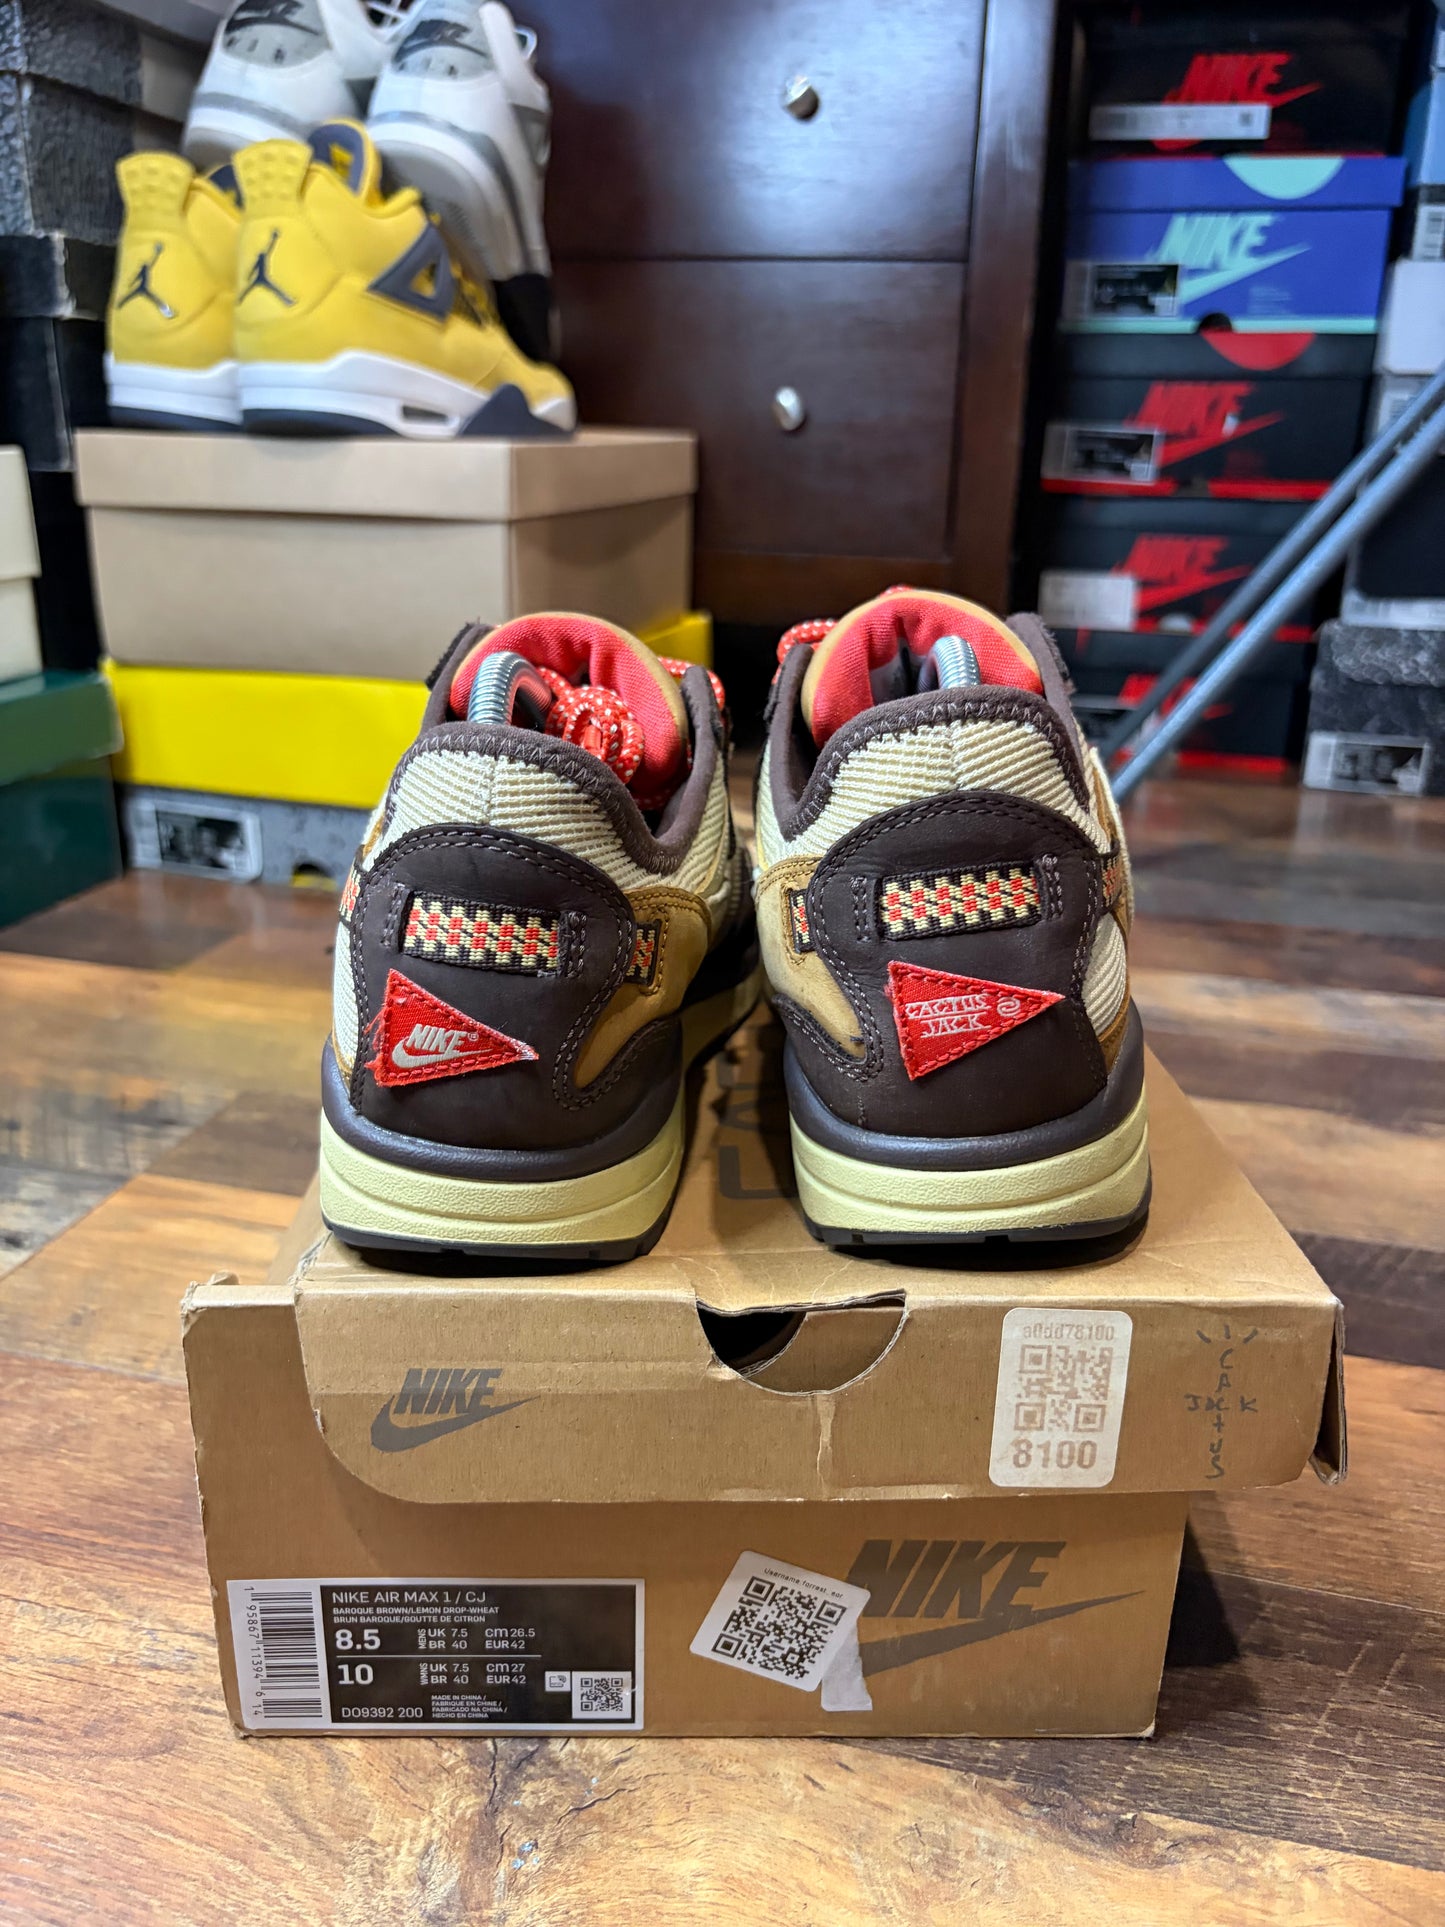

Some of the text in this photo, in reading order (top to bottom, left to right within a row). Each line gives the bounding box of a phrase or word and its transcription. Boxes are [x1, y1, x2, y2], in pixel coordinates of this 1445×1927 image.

[1174, 53, 1292, 103] NIKE
[1152, 213, 1277, 270] NIKE
[905, 993, 991, 1019] CACTUS
[920, 1012, 991, 1038] JACK
[406, 1023, 468, 1057] NIKE
[393, 1367, 504, 1415] NIKE
[1012, 1438, 1098, 1470] 8100
[845, 1539, 1067, 1619] NIKE
[332, 1591, 370, 1604] NIKE
[374, 1591, 400, 1603] AIR
[404, 1591, 439, 1603] MAX
[443, 1591, 452, 1603] 1
[465, 1591, 486, 1603] CJ
[333, 1606, 499, 1615] BAROQUE BROWN/LEMON DROP-WHEAT
[333, 1615, 486, 1624] BRUN BAROQUE/GOUTTE DE CITRON
[246, 1605, 260, 1640] 95867
[428, 1628, 446, 1637] UK
[451, 1628, 468, 1637] 7.5
[335, 1629, 381, 1650] 8.5
[418, 1628, 427, 1650] MENS
[429, 1640, 446, 1649] BR
[452, 1640, 467, 1649] 40
[250, 1646, 264, 1679] 11394
[420, 1662, 428, 1685] WMNS
[430, 1663, 448, 1672] UK
[453, 1663, 469, 1672] 7.5
[337, 1664, 374, 1685] 10
[431, 1675, 447, 1684] BR
[453, 1675, 469, 1684] 40
[341, 1707, 423, 1718] DO9392 200
